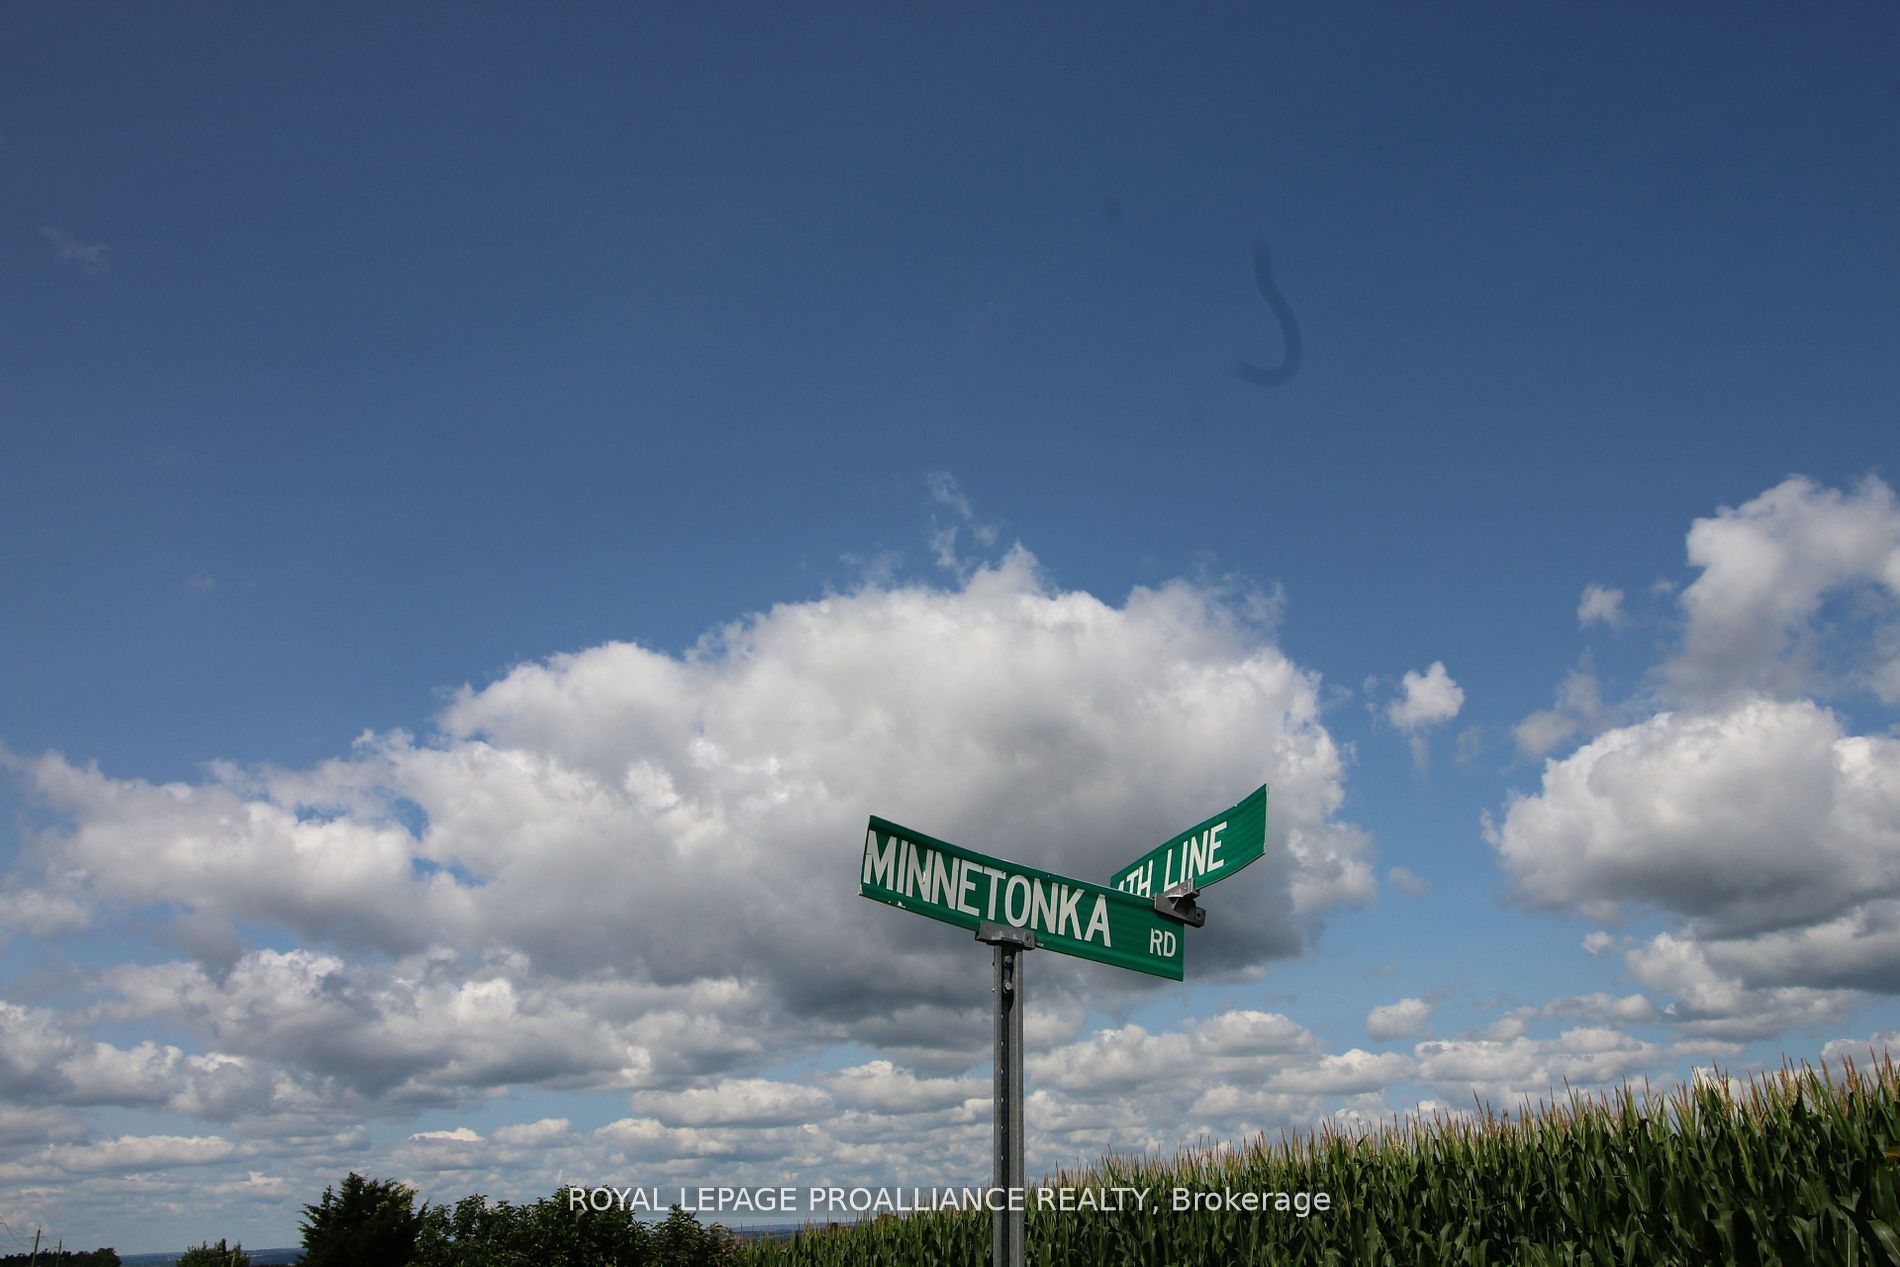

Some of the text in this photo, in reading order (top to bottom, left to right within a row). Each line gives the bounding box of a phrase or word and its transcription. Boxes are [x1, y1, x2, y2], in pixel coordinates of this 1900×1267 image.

[864, 830, 1177, 957] MINNETONKA RD
[1118, 821, 1227, 897] TH LINE
